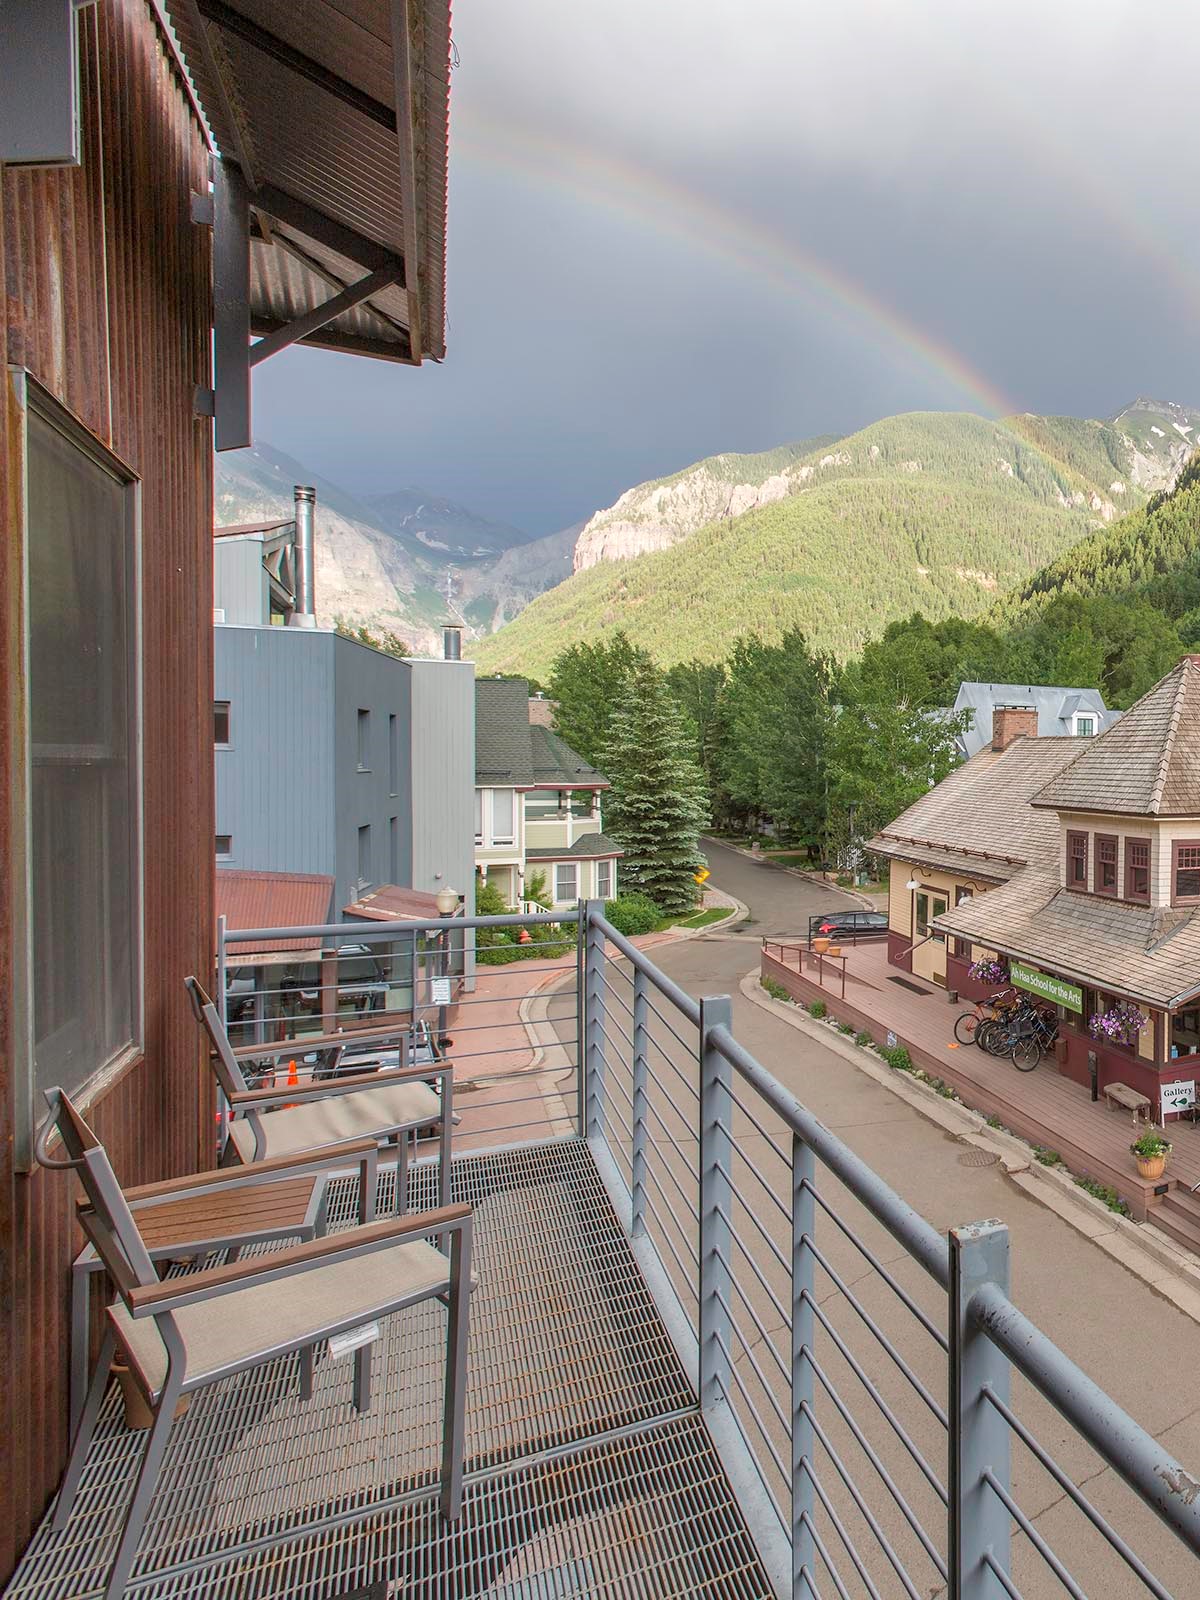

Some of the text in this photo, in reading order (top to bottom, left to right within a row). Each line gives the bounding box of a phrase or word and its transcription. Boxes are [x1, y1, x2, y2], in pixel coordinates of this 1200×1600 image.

[1011, 967, 1019, 979] Ah
[1020, 970, 1030, 983] Haa
[1030, 974, 1049, 991] School
[1049, 982, 1057, 995] for
[1057, 986, 1068, 1000] the
[1068, 990, 1081, 1005] Arts
[1163, 1087, 1193, 1097] Gallery
